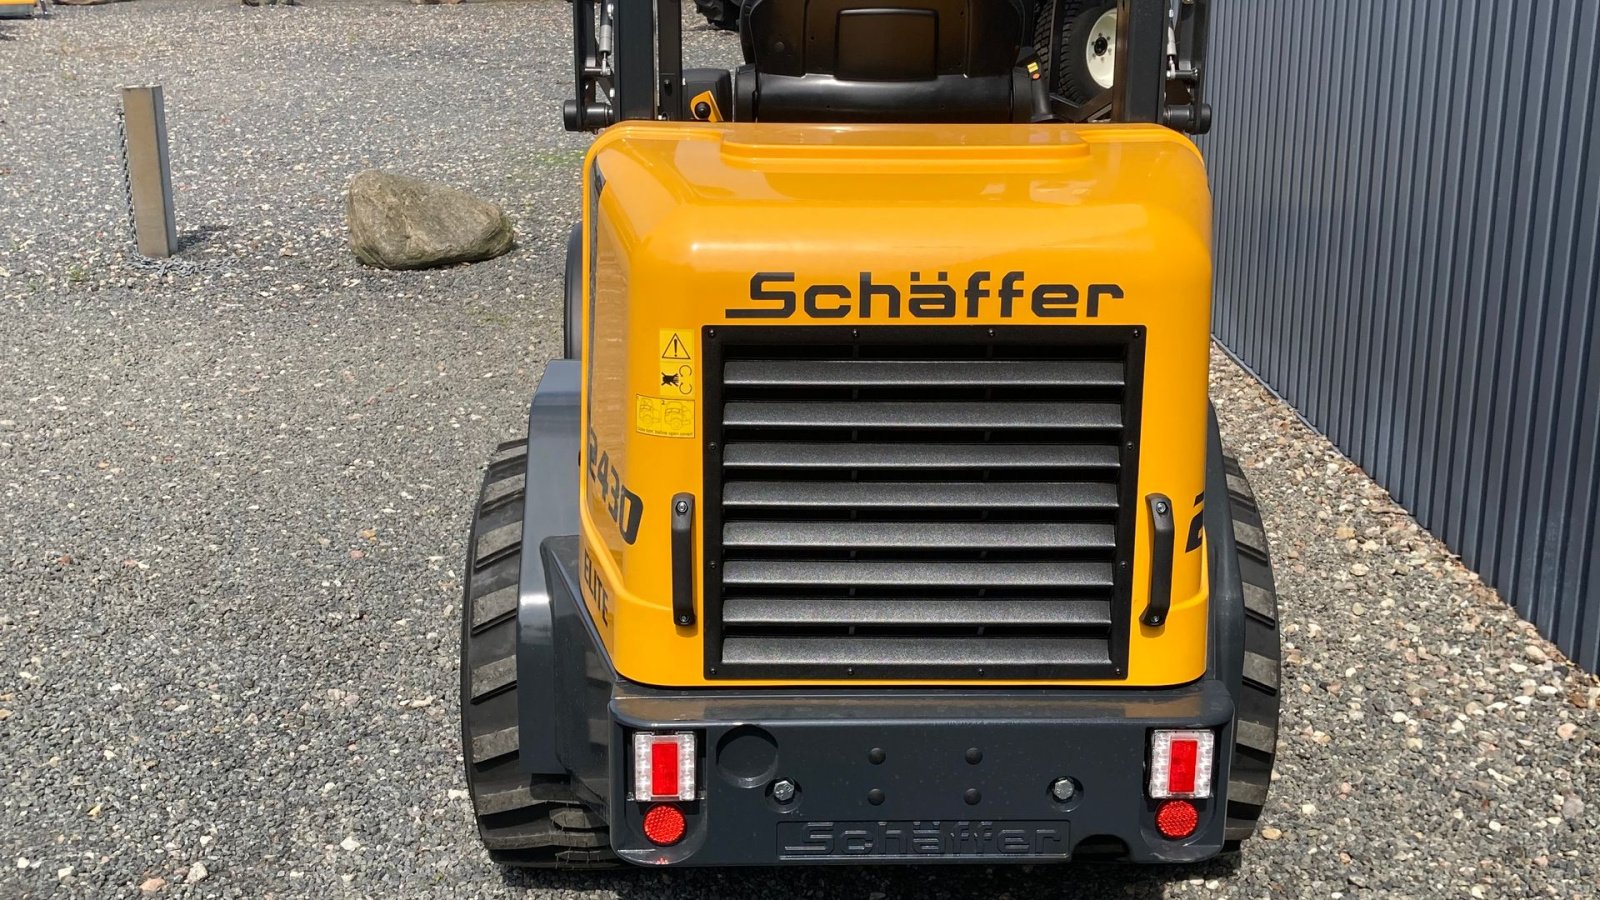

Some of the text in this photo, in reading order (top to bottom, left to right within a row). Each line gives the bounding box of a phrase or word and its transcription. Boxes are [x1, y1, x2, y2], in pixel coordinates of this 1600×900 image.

[725, 271, 1124, 318] Schäffer
[588, 427, 643, 545] 2430
[584, 549, 608, 627] ELITE
[784, 821, 1062, 855] Schäffer
